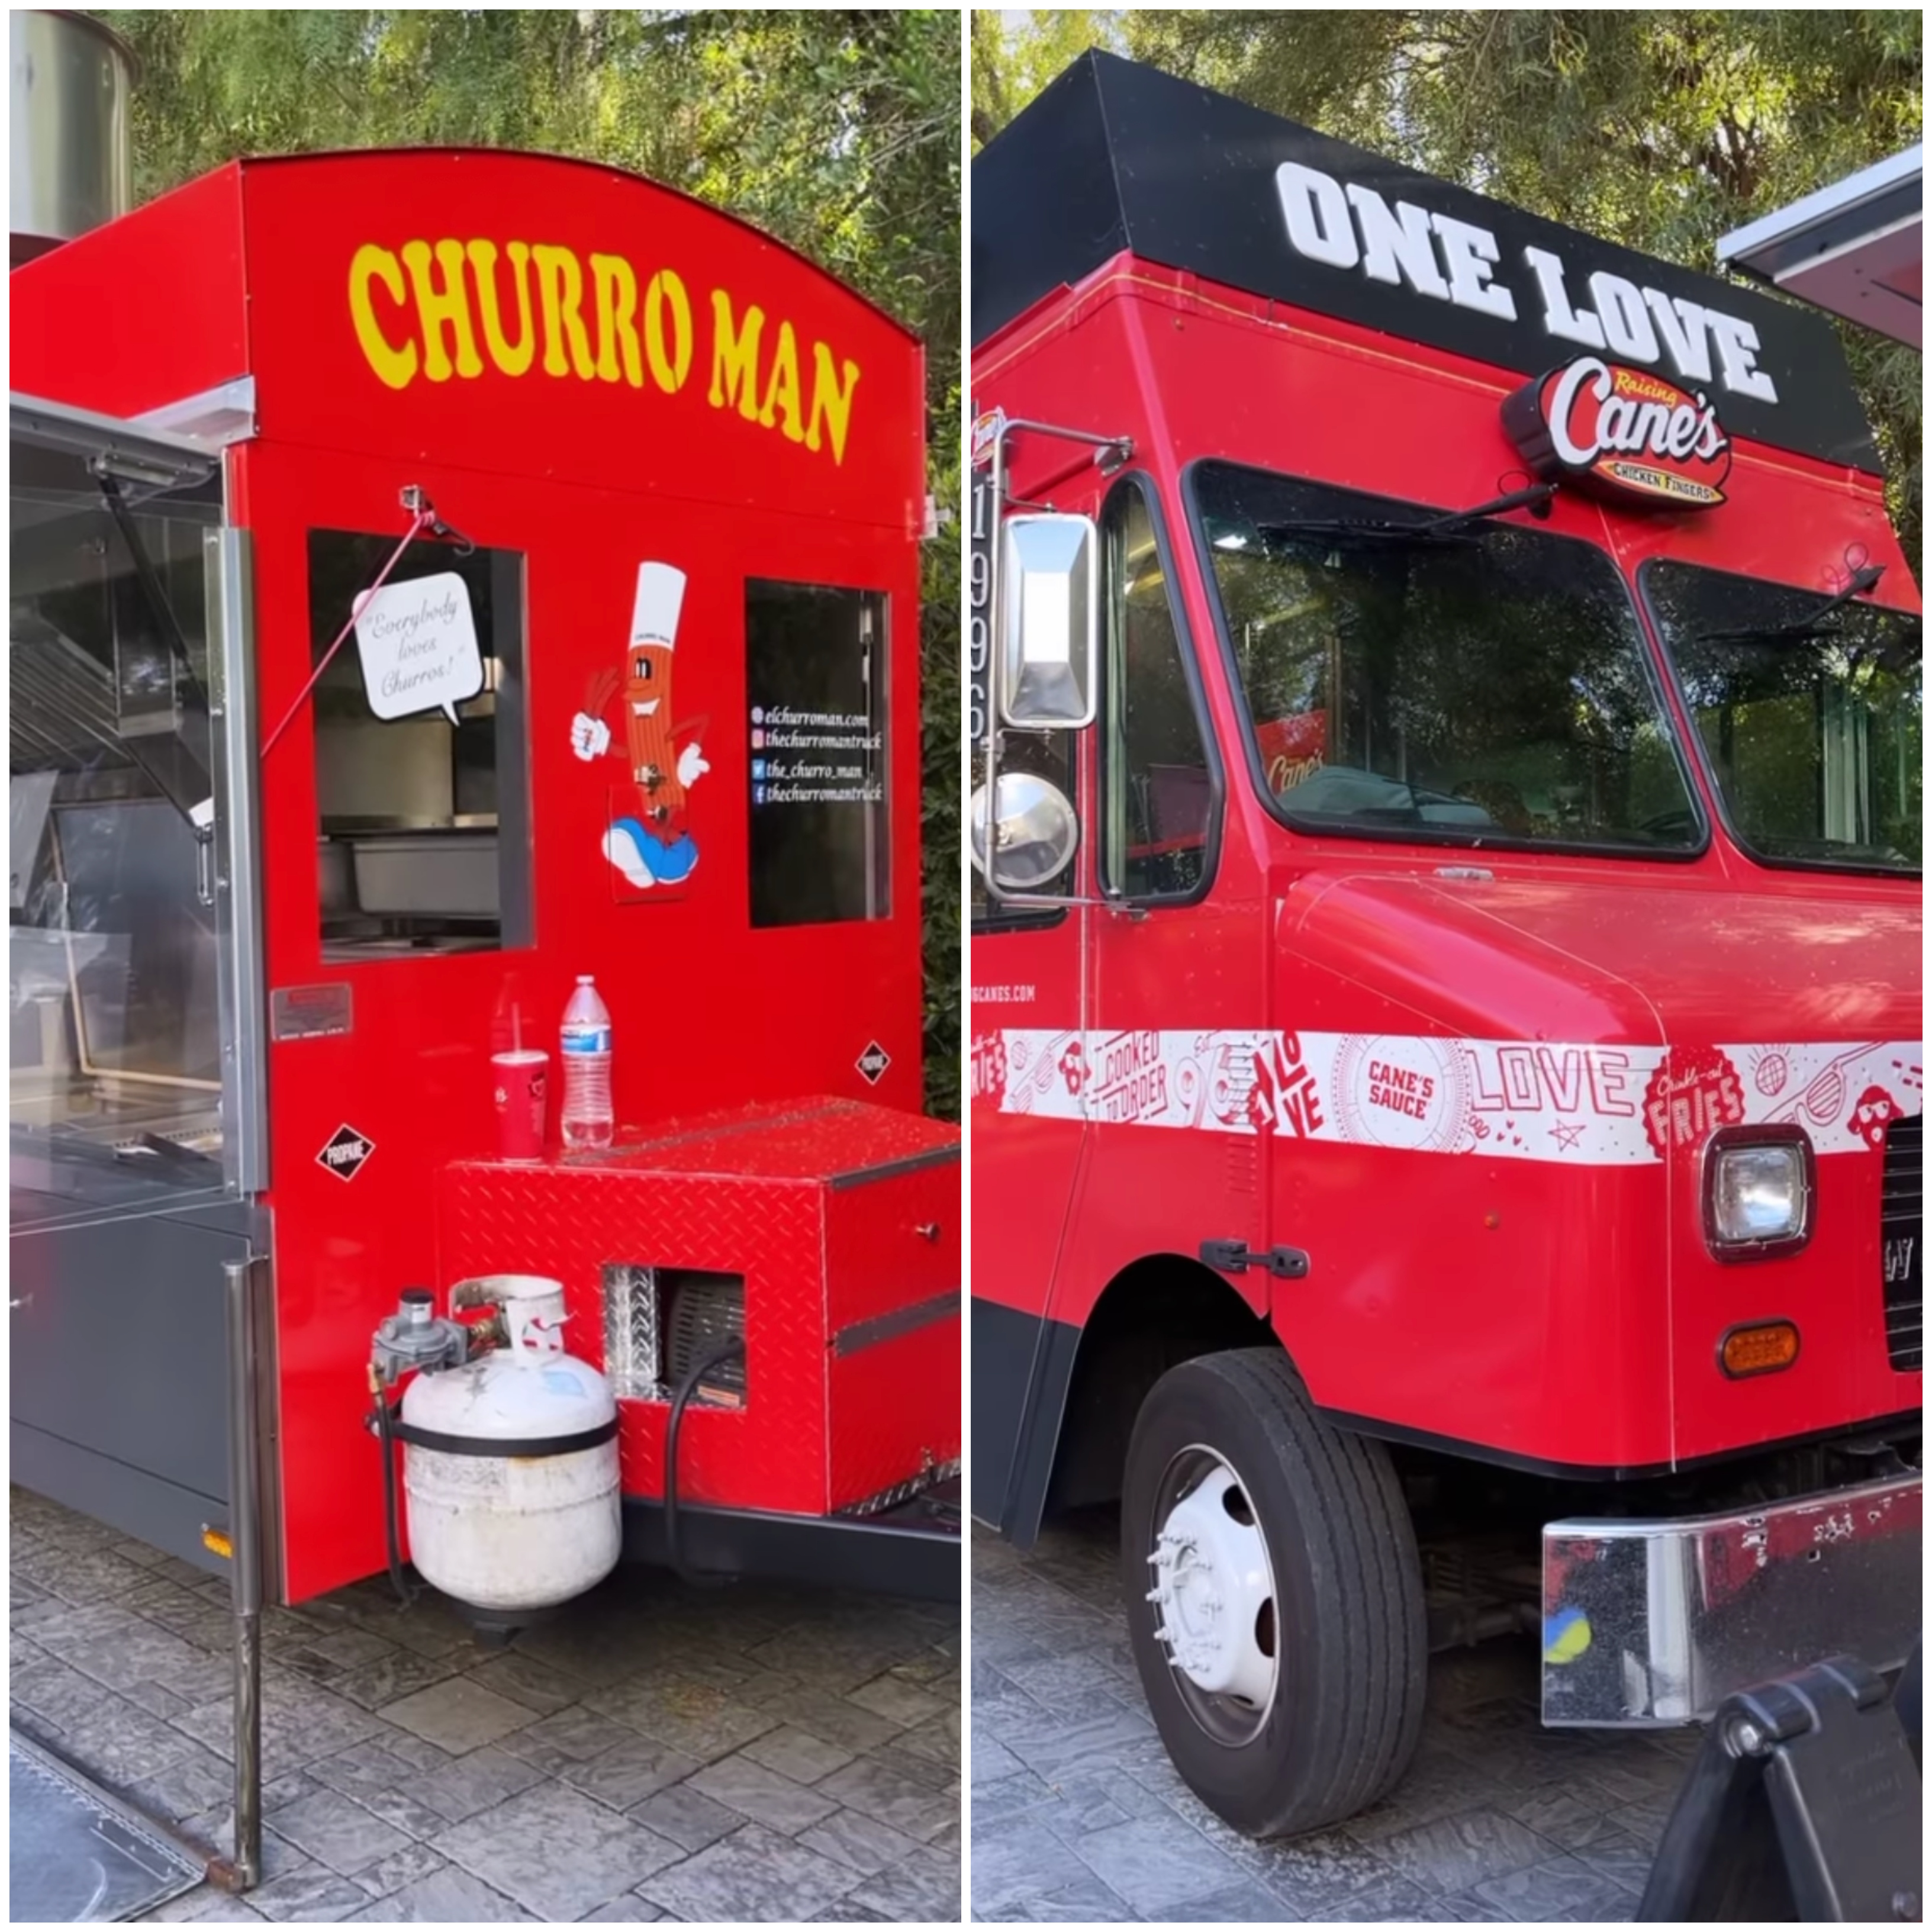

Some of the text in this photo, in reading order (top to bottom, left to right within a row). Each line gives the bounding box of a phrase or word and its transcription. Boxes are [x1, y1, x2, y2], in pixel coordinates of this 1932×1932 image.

[1276, 161, 1778, 404] ONE LOVE
[349, 238, 859, 466] CHURRO MAN
[1549, 356, 1728, 465] Cane's
[1614, 369, 1678, 408] Raising
[1612, 462, 1711, 500] CHICKEN FINGERS
[398, 636, 437, 661] loves
[765, 706, 868, 726] elchurroman.com
[970, 984, 1035, 1003] GCANES.COM
[1105, 1030, 1160, 1088] COOKED
[1368, 1060, 1434, 1098] CANE'S
[1466, 1047, 1635, 1117] LOVE
[1121, 1064, 1168, 1118] ORDER
[1369, 1084, 1427, 1120] SAUCE
[1648, 1076, 1741, 1146] FRIES
